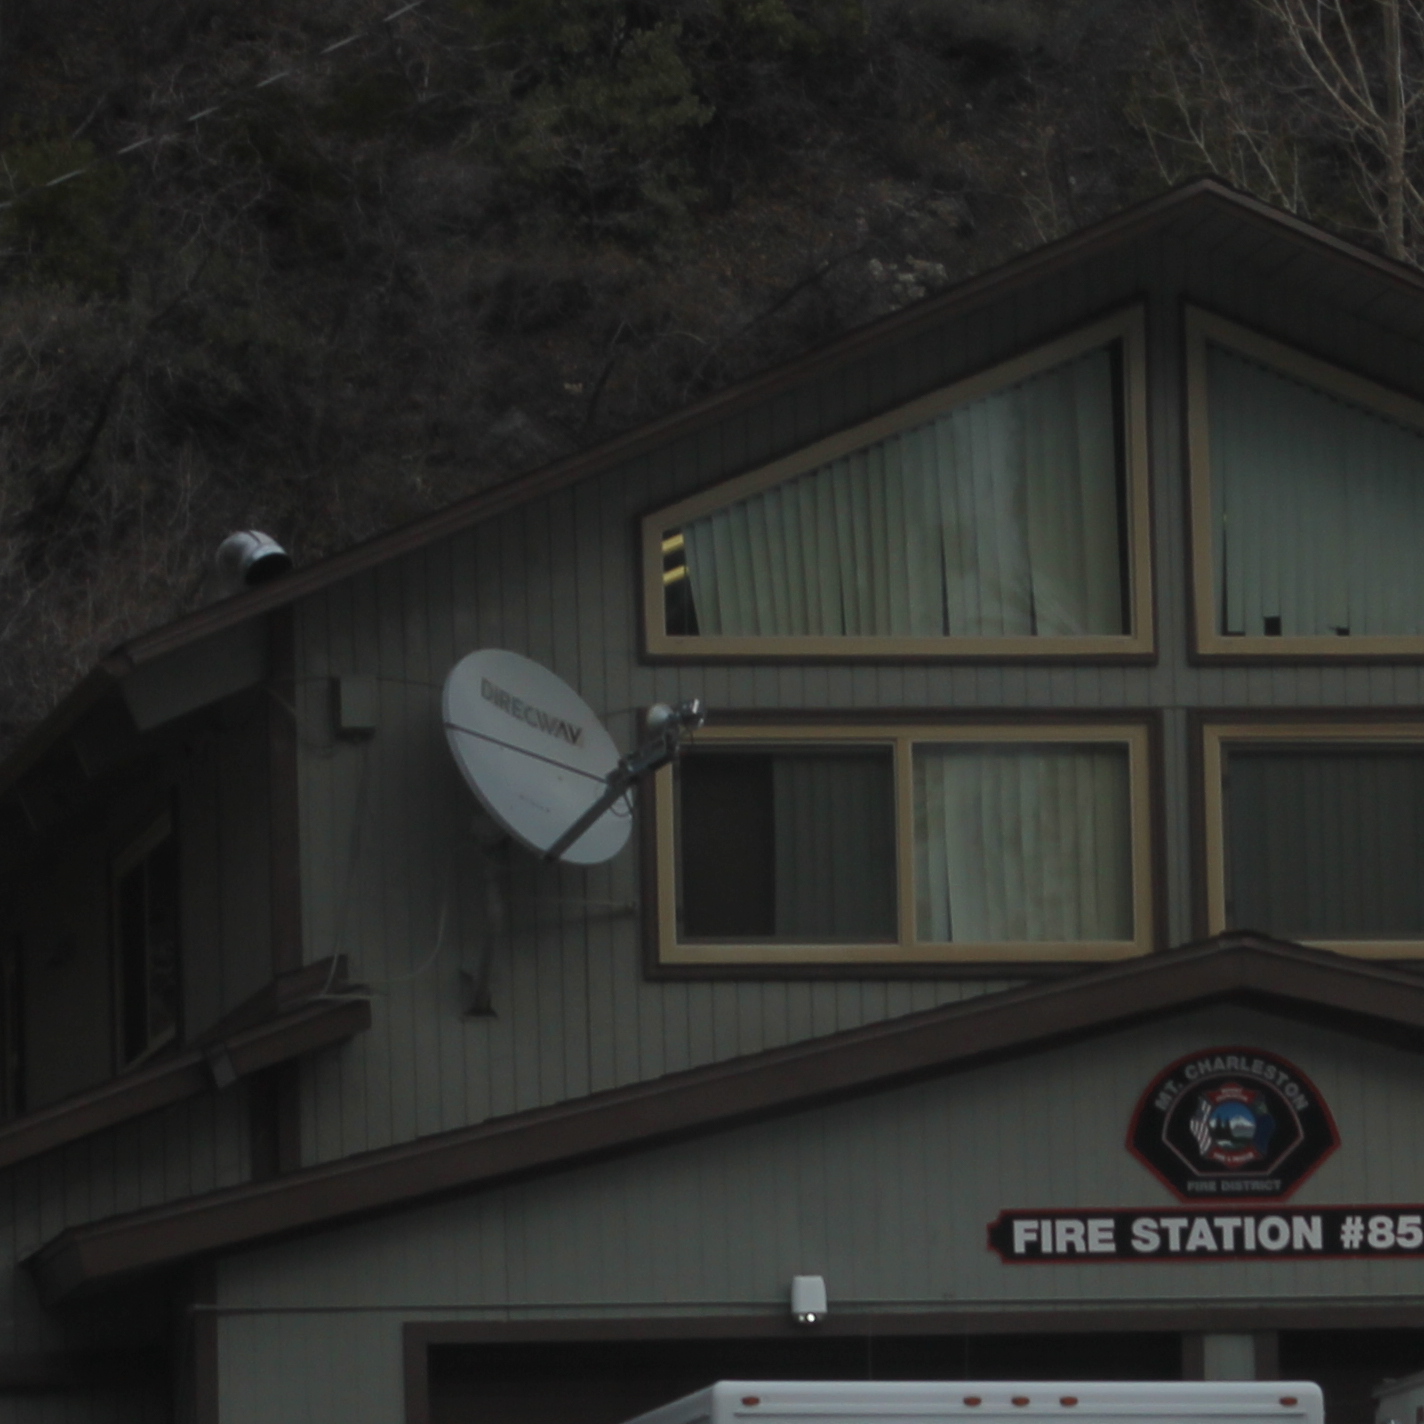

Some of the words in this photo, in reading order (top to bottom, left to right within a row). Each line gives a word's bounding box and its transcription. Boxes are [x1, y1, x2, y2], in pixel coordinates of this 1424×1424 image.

[481, 677, 583, 746] DIRECWAY
[1154, 1079, 1184, 1112] MT.
[1184, 1055, 1309, 1111] CHARLESTON
[1187, 1180, 1217, 1192] FIRE
[1221, 1179, 1282, 1191] DISTRICT
[1013, 1218, 1116, 1254] FIRE
[1131, 1215, 1323, 1252] STATION
